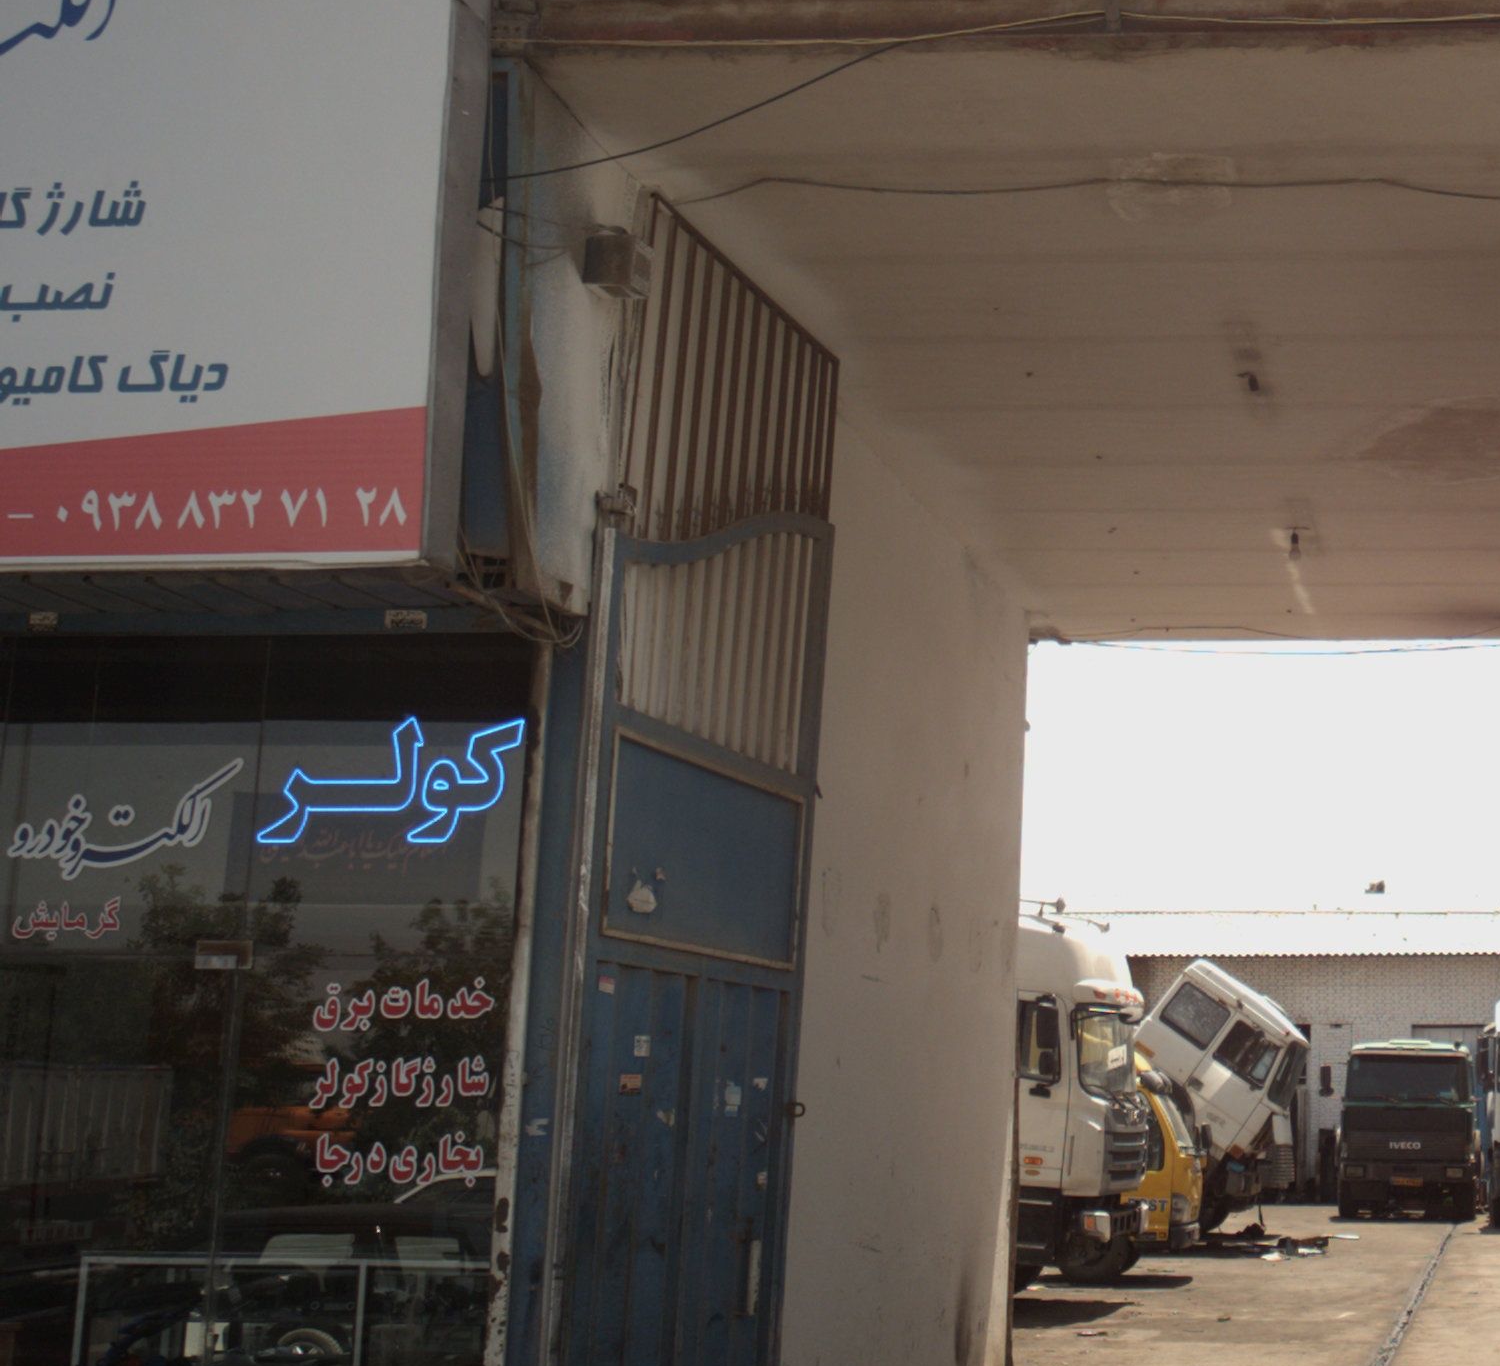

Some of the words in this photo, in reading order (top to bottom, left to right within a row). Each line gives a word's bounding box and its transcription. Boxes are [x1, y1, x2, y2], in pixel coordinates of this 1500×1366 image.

[37, 180, 146, 236] شارژ
[118, 350, 229, 403] دیاگ
[56, 489, 163, 531] ۰۹۳۸
[178, 488, 262, 529] ۸۳۲
[280, 488, 328, 528] ۷۱
[356, 487, 408, 527] ۲۸
[257, 716, 525, 844] کولر
[12, 897, 121, 941] گرمایش
[313, 983, 376, 1031] برق
[381, 977, 495, 1019] خدمات
[309, 1057, 374, 1108] کولر
[369, 1057, 421, 1107] گاز
[416, 1054, 489, 1107] شارژ
[389, 1131, 483, 1187] بخاری
[1389, 1141, 1422, 1151] IVECO
